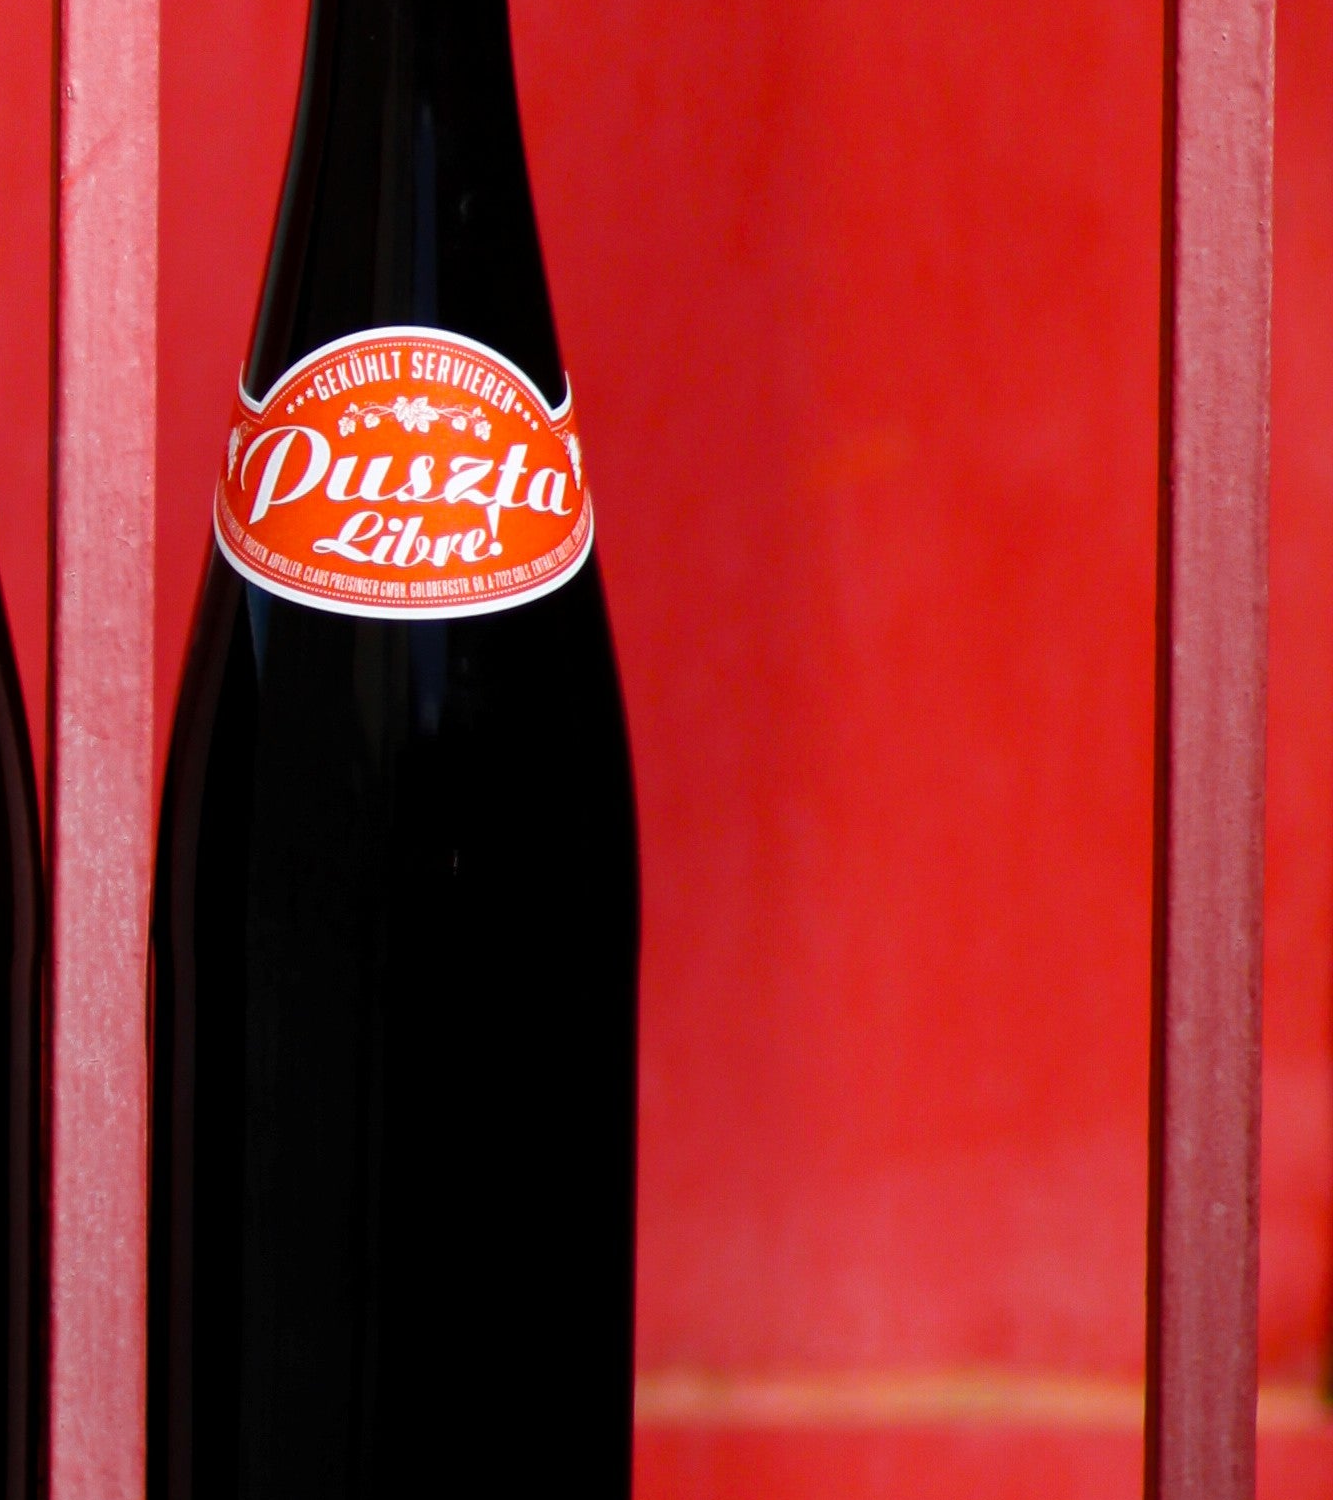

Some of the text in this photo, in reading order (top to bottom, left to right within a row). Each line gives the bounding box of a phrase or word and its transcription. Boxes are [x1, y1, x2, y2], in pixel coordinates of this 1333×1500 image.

[313, 350, 518, 414] GEKÜHLT SERVIEREN
[240, 425, 572, 525] Puszta
[312, 503, 503, 567] Libre!
[303, 566, 329, 587] CLAUS
[330, 572, 379, 596] PREISINGER
